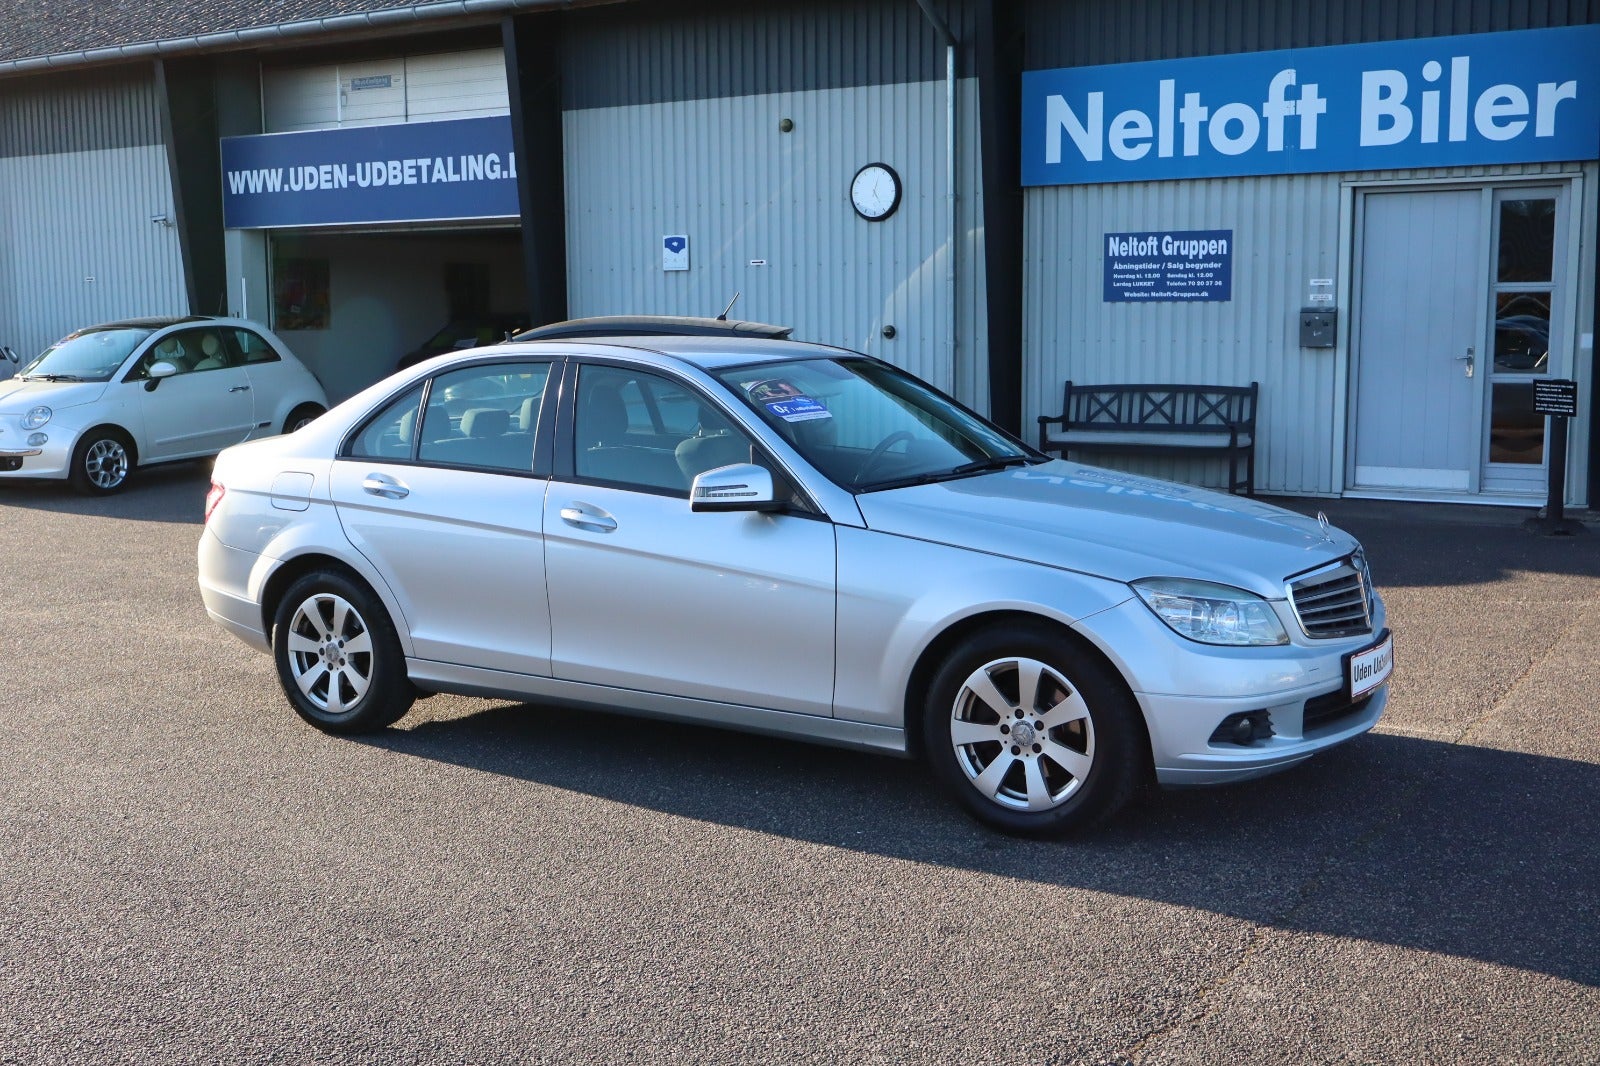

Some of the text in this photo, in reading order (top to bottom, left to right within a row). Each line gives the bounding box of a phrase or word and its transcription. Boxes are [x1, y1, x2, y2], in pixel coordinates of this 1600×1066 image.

[1045, 55, 1578, 164] Neltoft Biler
[1108, 235, 1228, 260] Neltoft Gruppen
[1113, 261, 1222, 271] Åbningstider / Salg begynder
[1353, 663, 1372, 682] Uden
